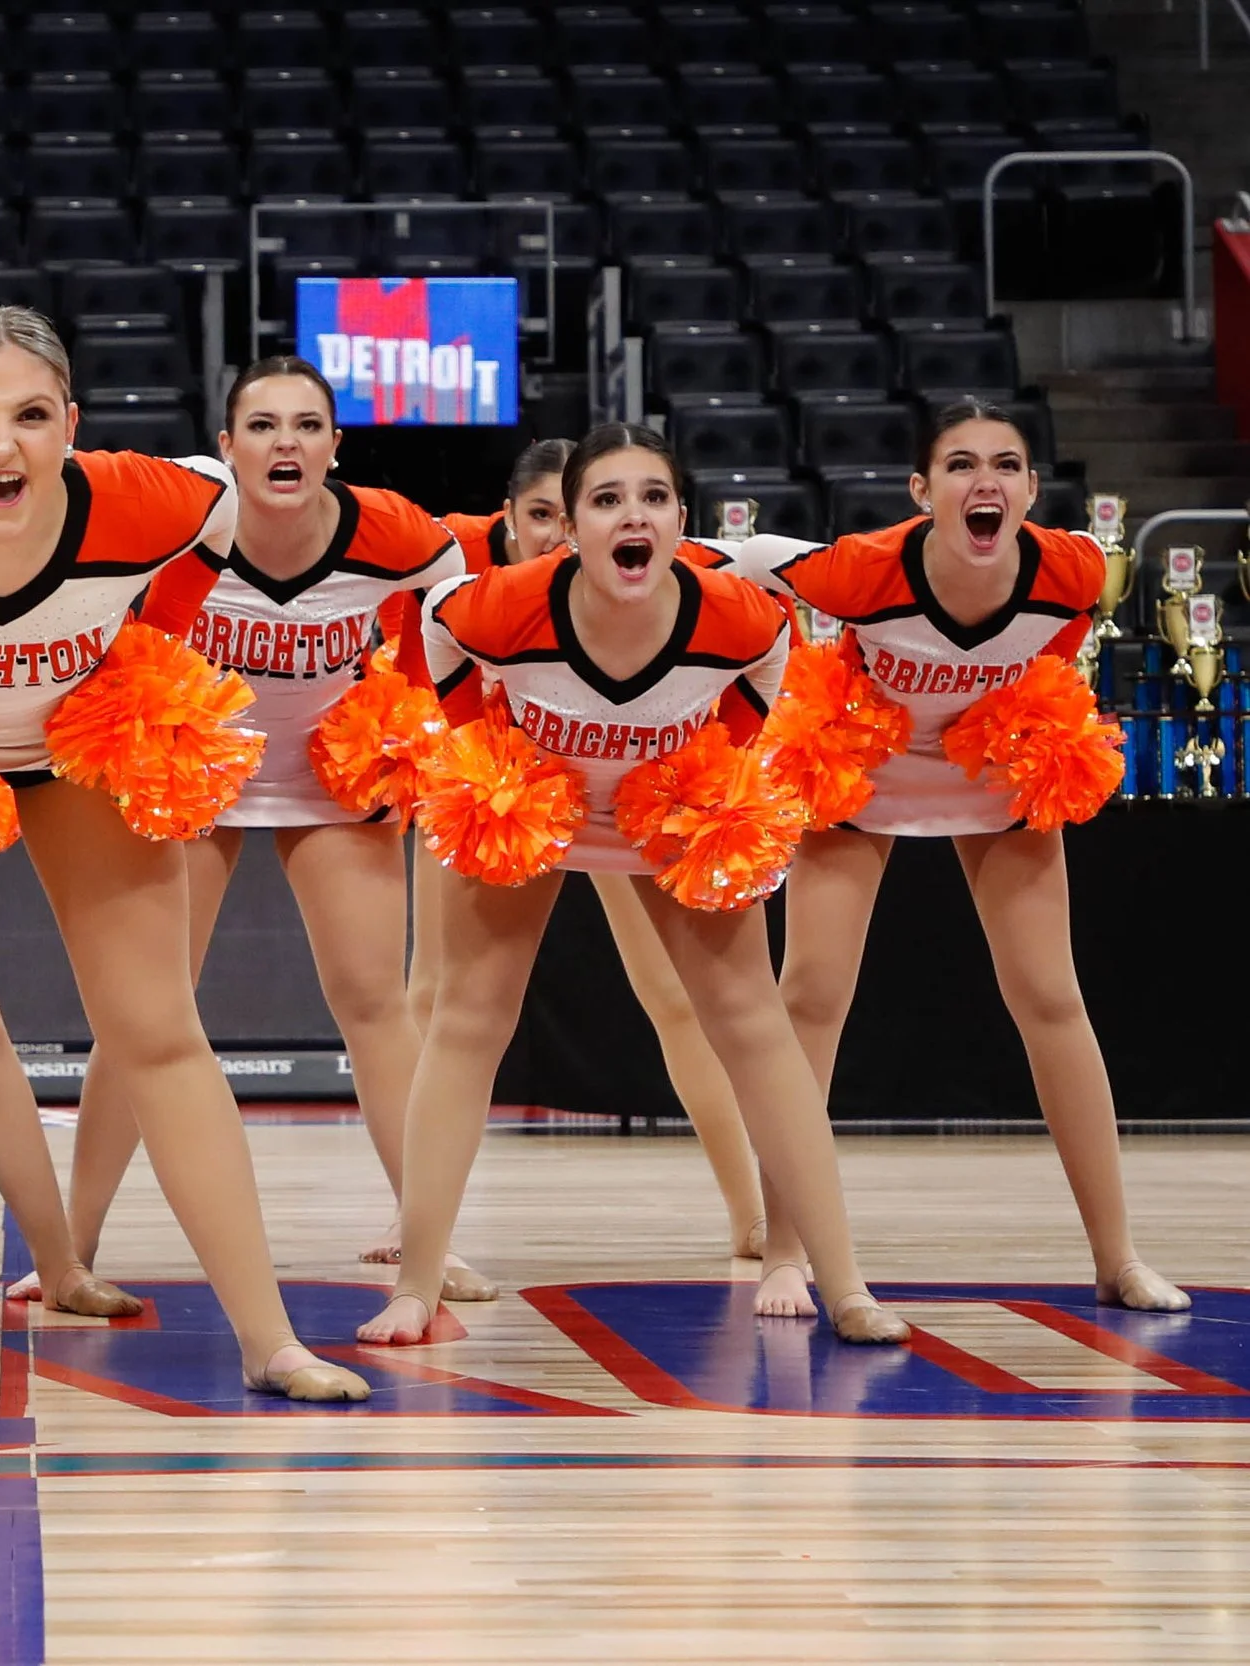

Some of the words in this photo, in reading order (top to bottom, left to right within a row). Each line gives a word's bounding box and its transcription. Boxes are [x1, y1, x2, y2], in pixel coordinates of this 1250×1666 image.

[191, 609, 367, 679] BRIGHTON
[872, 648, 1034, 695] BRIGHTO
[216, 1055, 294, 1075] aesars
